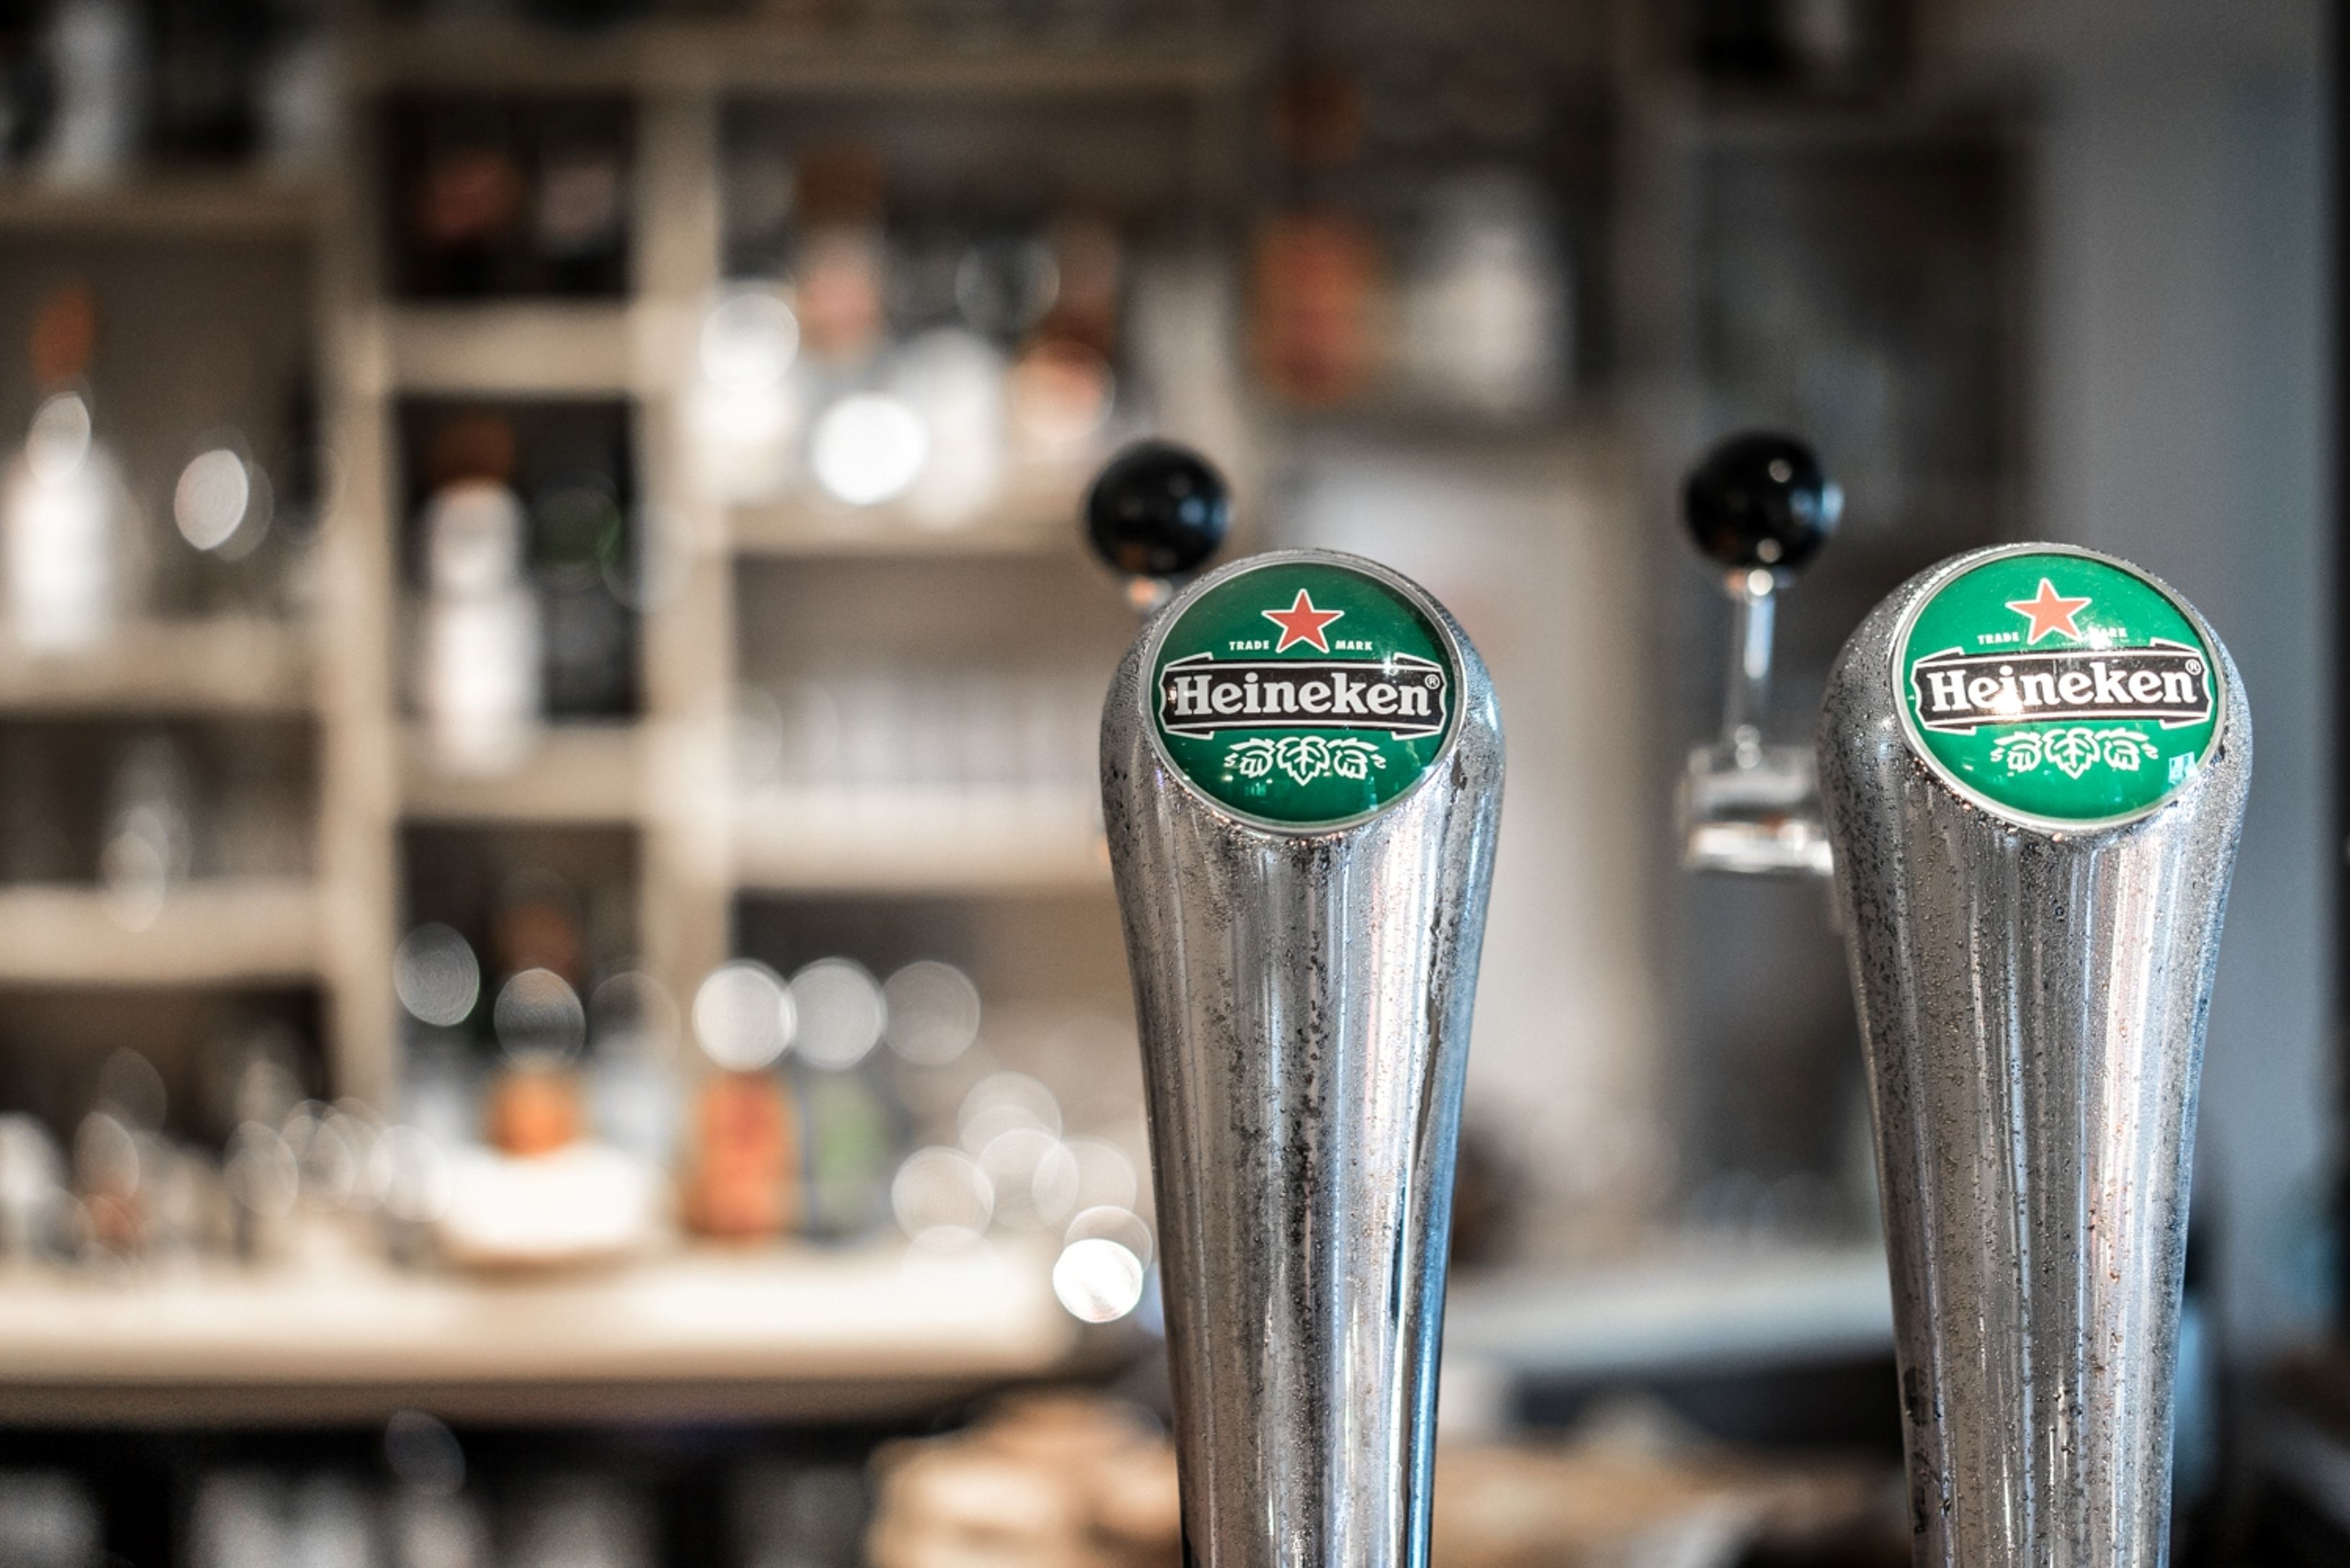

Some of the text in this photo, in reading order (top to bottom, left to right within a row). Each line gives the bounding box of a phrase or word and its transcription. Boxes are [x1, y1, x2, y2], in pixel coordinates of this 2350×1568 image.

[1977, 631, 2020, 645] TRADE
[1228, 639, 1374, 651] TRADE MARK
